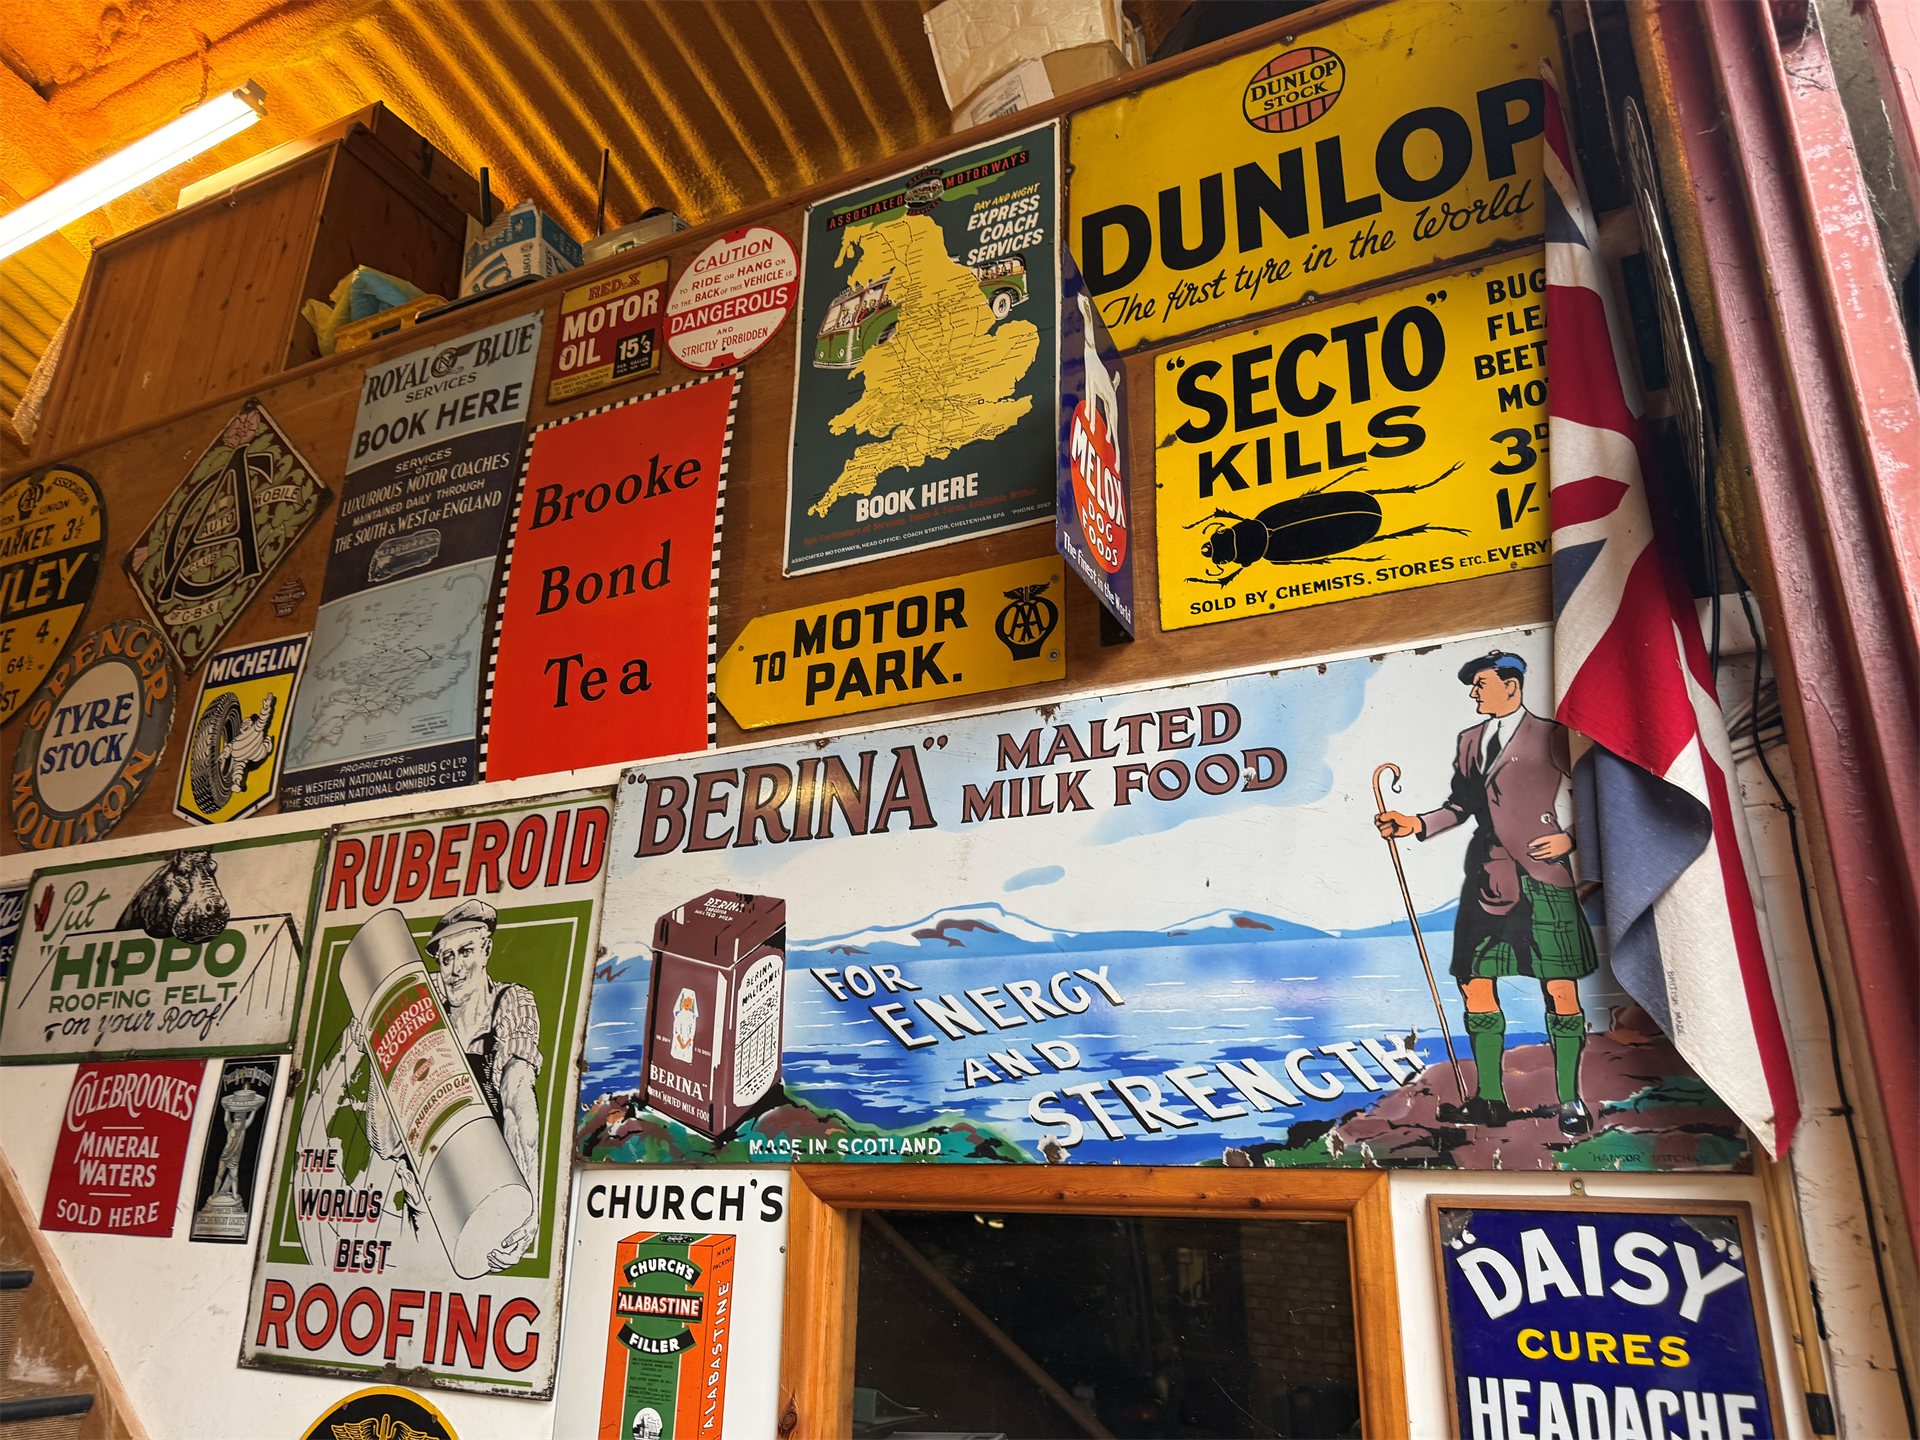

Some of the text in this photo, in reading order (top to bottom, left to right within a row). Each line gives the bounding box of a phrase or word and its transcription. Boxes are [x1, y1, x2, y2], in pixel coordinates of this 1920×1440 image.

[1251, 59, 1338, 102] DUNLOP
[1264, 82, 1329, 113] STOCK
[829, 151, 1027, 230] ASSOCIATED MOTORWAYS
[973, 182, 1041, 213] DAY AND NIGHT
[1082, 78, 1546, 297] DUNLOP
[966, 194, 1041, 232] EXPRESS
[980, 212, 1039, 244] COACH
[694, 237, 773, 273] CAUTION
[966, 228, 1045, 266] SERVICES
[1103, 178, 1534, 330] The first tyre in the World
[671, 303, 679, 311] TO
[681, 299, 691, 307] THE
[695, 288, 720, 303] BACK
[730, 284, 743, 293] THIS
[744, 269, 784, 289] VEHICLE
[692, 274, 722, 291] RIDE
[724, 273, 734, 281] OR
[737, 258, 772, 277] HANG
[775, 258, 786, 266] ON
[562, 288, 660, 343] MOTOR
[671, 287, 788, 335] DANGEROUS
[717, 326, 734, 336] AND
[364, 323, 536, 406] ROYAL BLUE
[558, 337, 601, 372] OIL
[681, 327, 768, 358] STRICTLY FORBIDDEN
[405, 372, 477, 403] SERVICES
[1165, 290, 1447, 444] "SECTO"
[354, 382, 523, 459] BOOK HERE
[395, 448, 453, 473] SERVICES
[415, 465, 428, 475] OF
[1071, 415, 1127, 529] MELOX
[1198, 405, 1426, 499] KILLS
[39, 499, 70, 515] UNION
[252, 487, 300, 507] MOBILE
[342, 452, 511, 517] LUXURIOUS MOTOR COACHES
[352, 479, 485, 527] MAINTAINED DAILY THROUGH
[529, 454, 701, 530] Brooke
[856, 472, 979, 522] BOOK HERE
[201, 511, 235, 536] AUTO
[335, 490, 503, 554] THE SOUTH & WEST OF ENGLAND
[863, 524, 871, 533] of
[933, 507, 940, 517] &
[969, 494, 1008, 509] Available
[1081, 506, 1118, 566] FOODS
[1088, 497, 1113, 543] DOG
[791, 511, 1006, 564] ASSOCIATED HEAD COACH CHELTENHAM SPA
[188, 551, 220, 574] CLUB
[536, 539, 671, 615] Bond
[1063, 530, 1077, 560] The
[1104, 581, 1115, 605] the
[1114, 592, 1132, 625] World
[1189, 589, 1237, 616] SOLD
[1245, 588, 1268, 607] BY
[1375, 556, 1455, 582] STORES
[793, 587, 968, 659] MOTOR
[30, 625, 169, 732] SPENCER
[207, 643, 302, 684] MICHELIN
[543, 653, 652, 708] Tea
[752, 650, 786, 685] TO
[805, 641, 963, 706] PARK.
[52, 692, 134, 739] TYRE
[996, 702, 1243, 773] MALTED
[40, 732, 127, 776] STOCK
[340, 755, 405, 774] PROPRIETORS
[13, 747, 157, 851] MOULTON
[287, 762, 437, 797] THE WESTERN NATIONAL OMNIBUS
[304, 791, 346, 807] SOUTHERN
[348, 783, 393, 800] NATIONAL
[395, 775, 436, 791] OMNIBUS
[627, 734, 949, 860] "BERINA"
[960, 746, 1289, 824] MILK FOOD
[325, 805, 610, 911] RUBEROID
[43, 880, 111, 942] Put
[704, 897, 745, 913] BERINA
[40, 923, 270, 991] "HIPPO"
[746, 962, 773, 988] BERINA
[48, 981, 237, 1014] ROOFING FELT
[811, 962, 922, 1003] FOR
[1667, 970, 1685, 1037] BRITISH MADE
[94, 997, 238, 1047] your Roof!
[376, 996, 433, 1060] RUBEROID
[869, 964, 1126, 1052] ENERGY
[382, 1009, 436, 1071] ROOFING
[963, 1040, 1083, 1090] AND
[66, 1070, 198, 1132] COLEBROOKES
[415, 1082, 453, 1129] RUBEROID
[662, 1093, 696, 1116] MALTED MILK
[1029, 1030, 1430, 1150] STRENGTH
[73, 1131, 160, 1165] MINERAL
[300, 1148, 337, 1174] THE
[750, 1137, 942, 1156] MADE IN SCOTLAND
[78, 1159, 158, 1188] WATERS
[56, 1198, 160, 1228] SOLD HERE
[298, 1182, 383, 1224] WORLD'S
[586, 1178, 783, 1223] CHURCH'S
[333, 1239, 392, 1275] BEST
[630, 1258, 695, 1281] CHURCH'S
[712, 1256, 733, 1271] PACKING
[717, 1245, 731, 1257] NEW
[1450, 1225, 1745, 1324] "DAISY"
[255, 1279, 541, 1373] ROOFING
[629, 1331, 681, 1354] FILLER
[1517, 1327, 1690, 1368] CURES
[1467, 1375, 1757, 1440] HEADACHE
